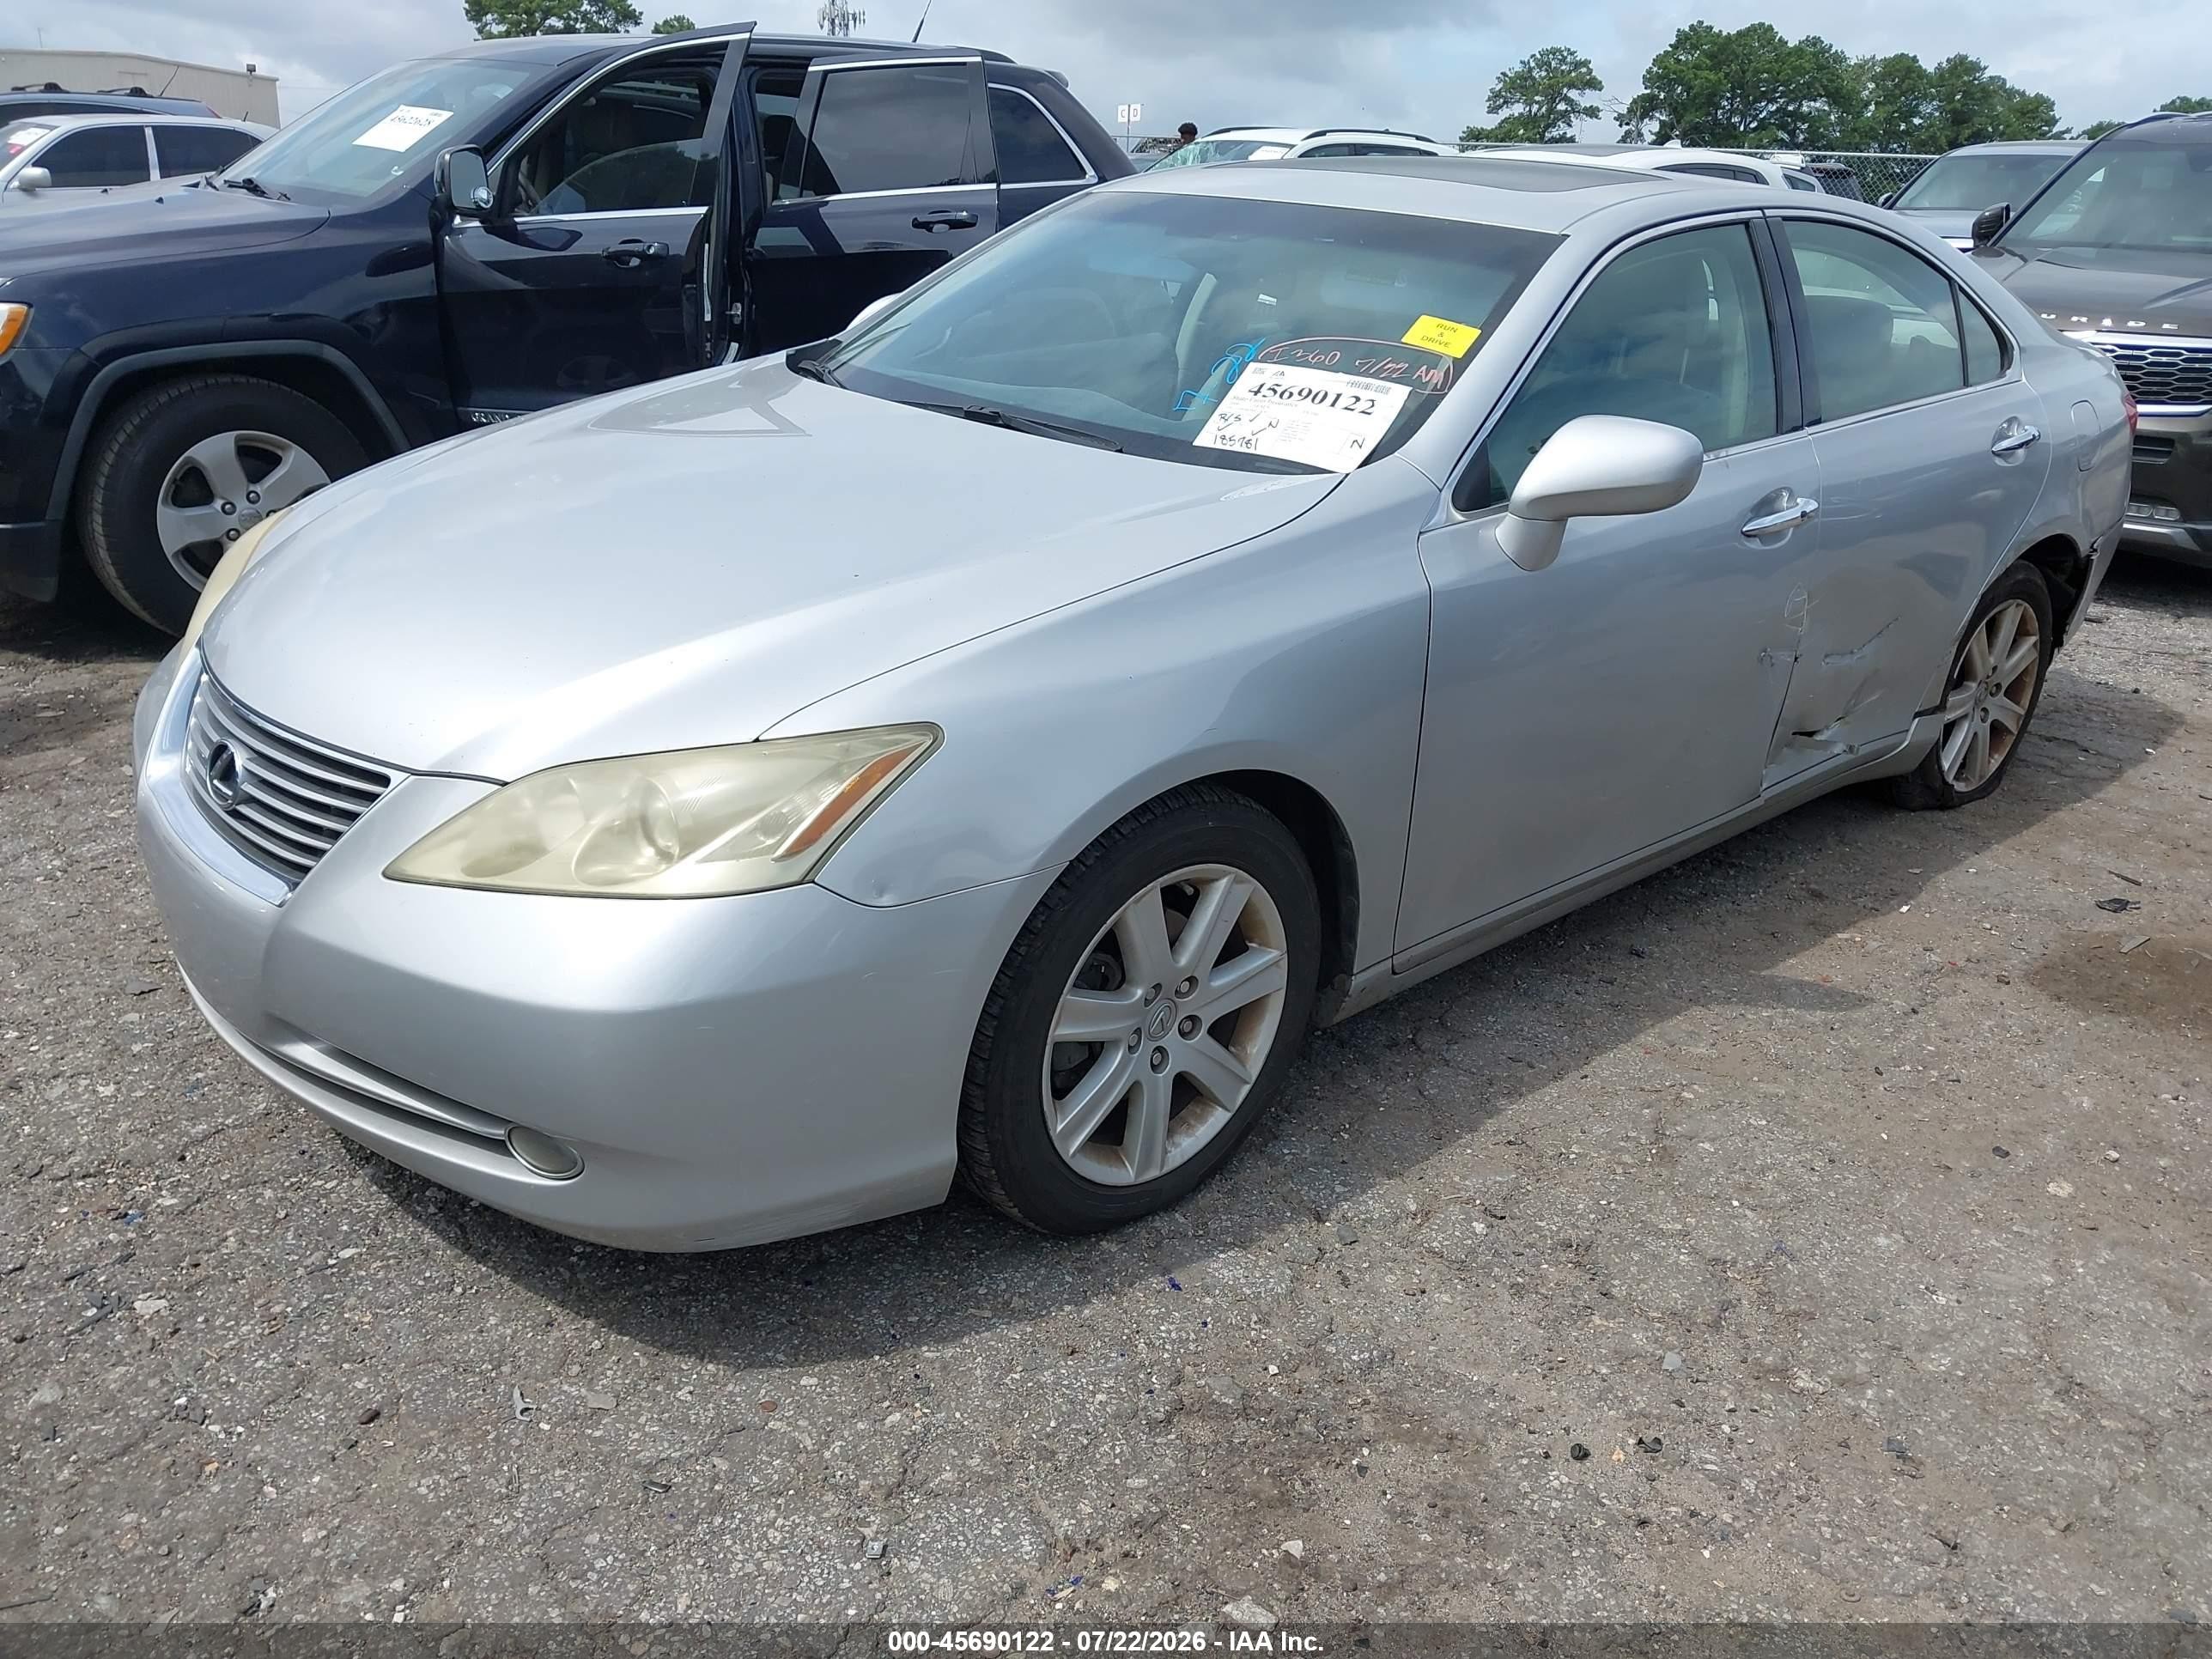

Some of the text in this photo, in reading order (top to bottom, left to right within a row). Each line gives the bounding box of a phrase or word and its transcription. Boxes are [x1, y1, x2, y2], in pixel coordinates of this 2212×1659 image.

[1121, 109, 1126, 118] C
[1133, 108, 1139, 118] D
[1437, 323, 1458, 333] RUN
[1420, 335, 1450, 348] DRIVE
[1355, 357, 1413, 378] 7/22
[1248, 382, 1377, 416] 45690122
